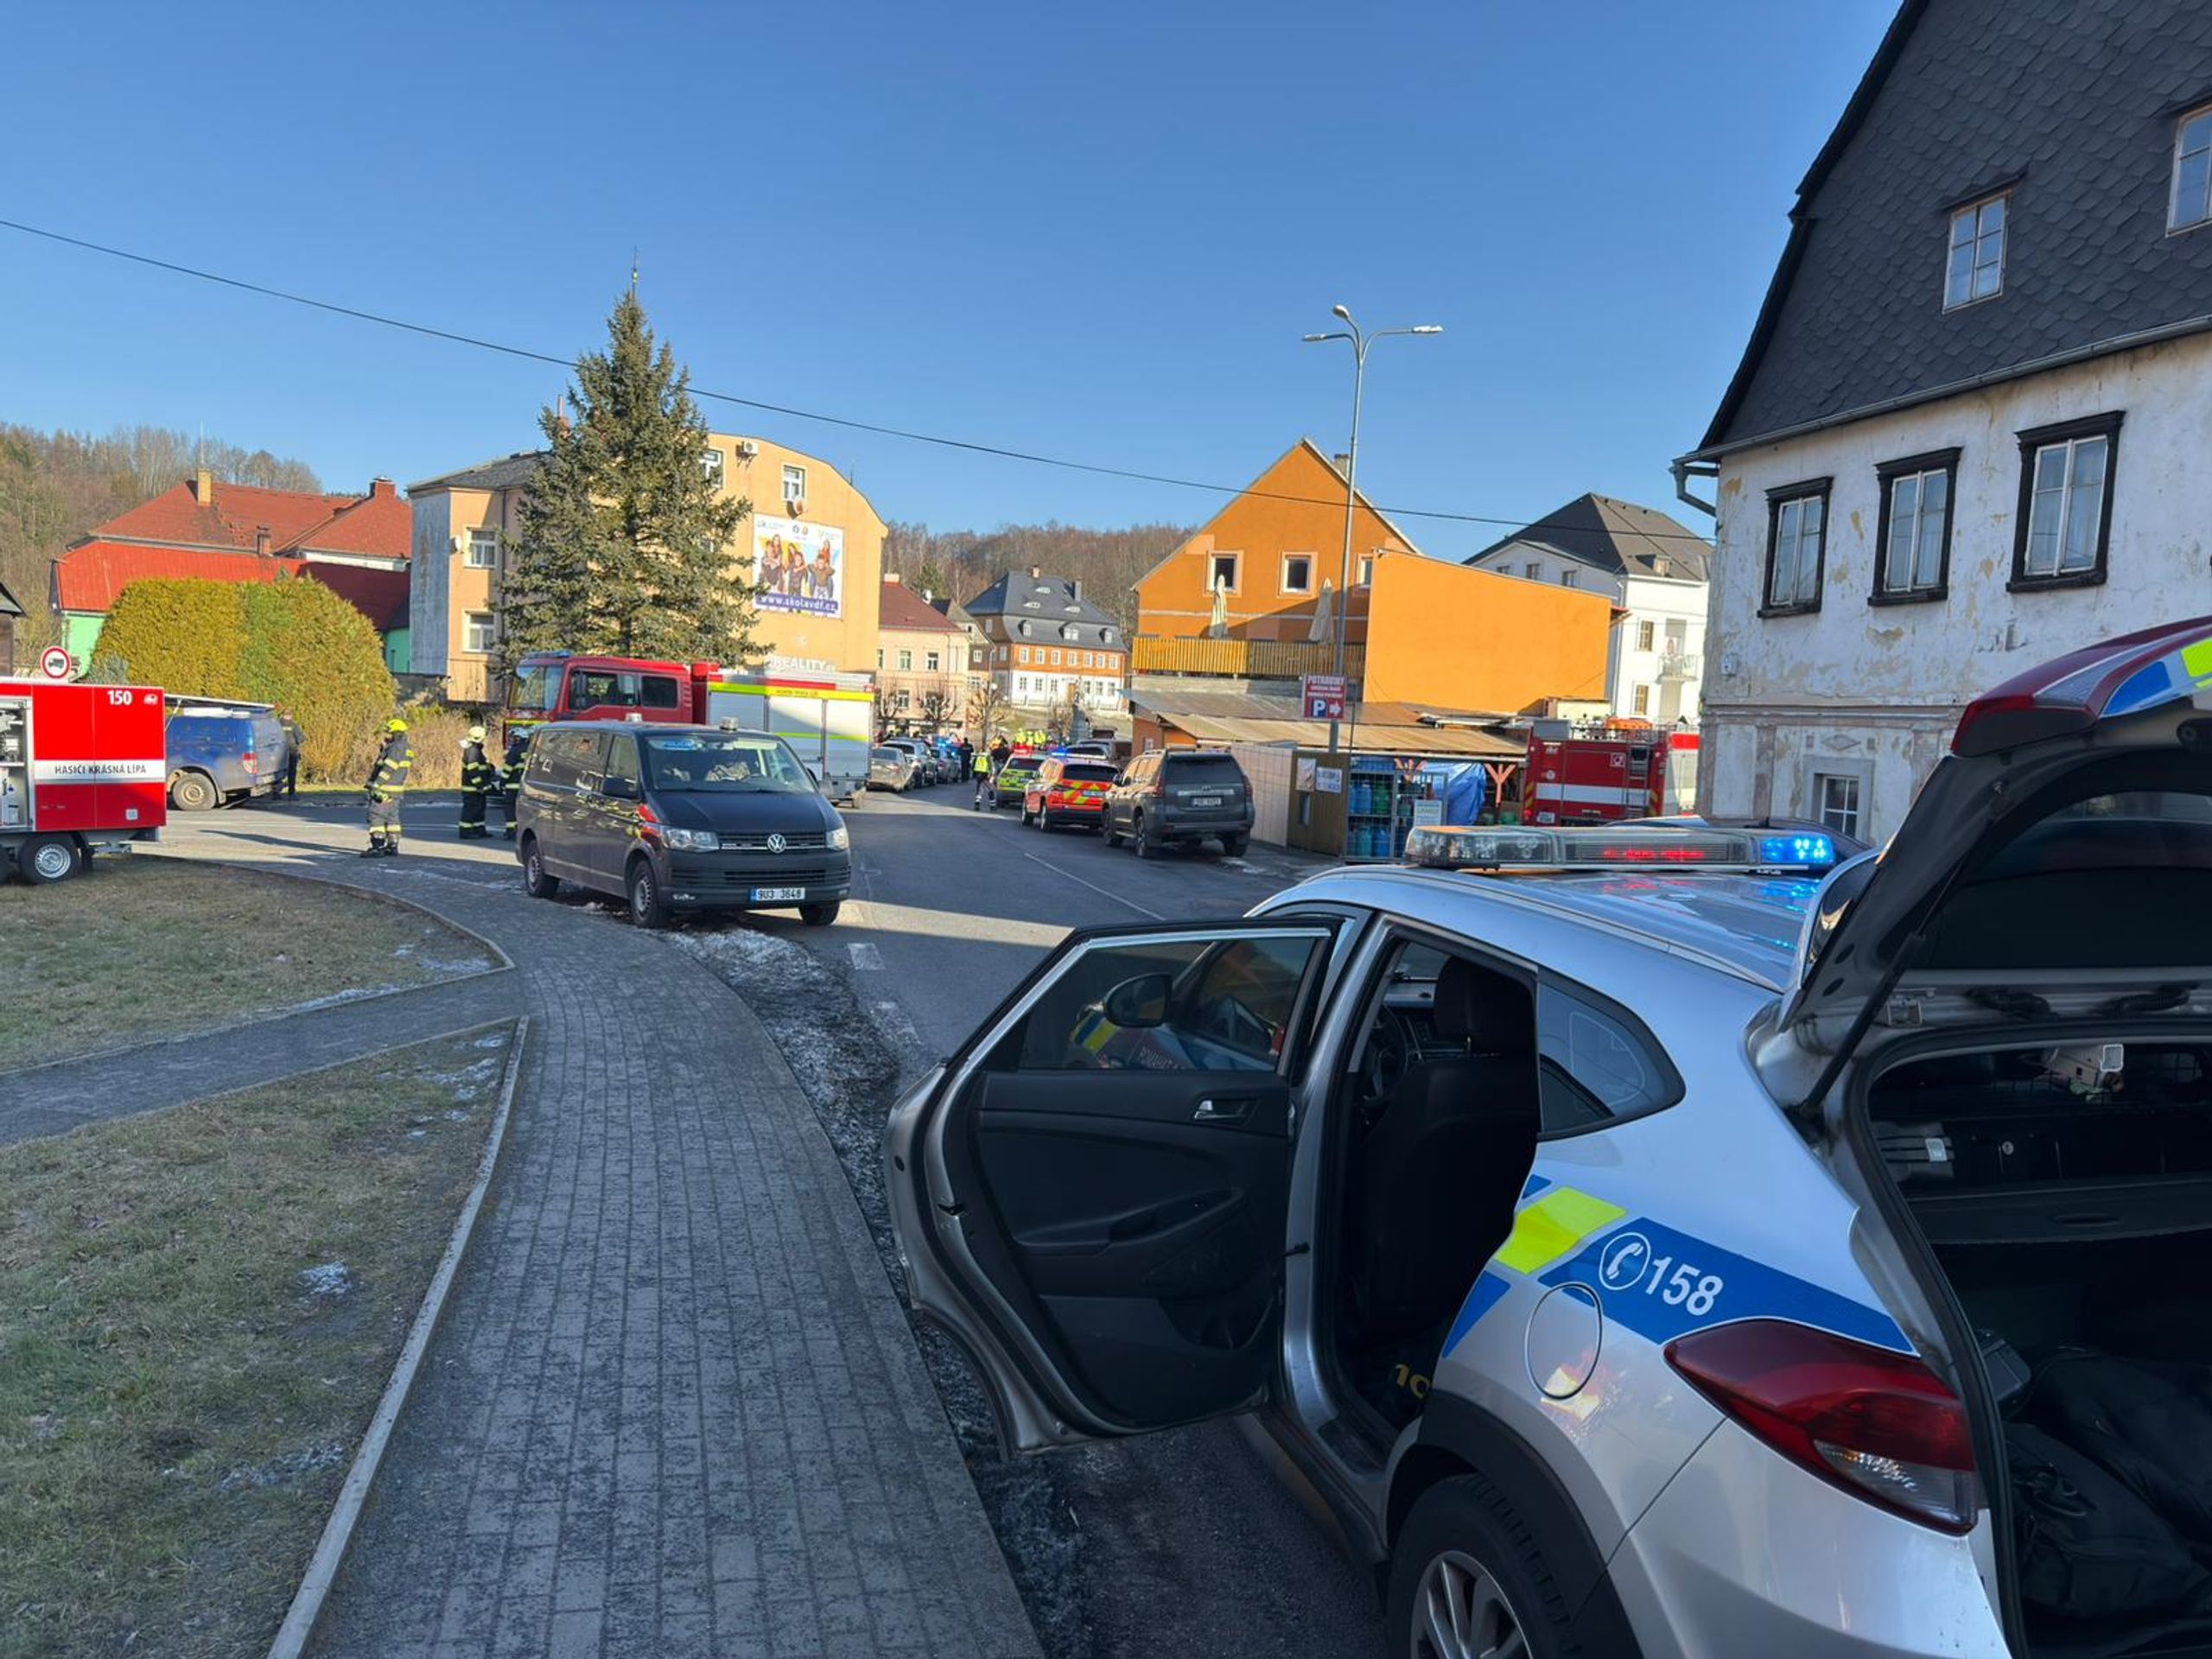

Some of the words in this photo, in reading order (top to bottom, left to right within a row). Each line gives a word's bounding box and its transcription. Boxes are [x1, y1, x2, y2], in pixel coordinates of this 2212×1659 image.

[107, 690, 132, 706] 150
[1313, 700, 1325, 716] P
[54, 765, 86, 774] HASIČI
[88, 764, 125, 774] KRÁSNÁ
[127, 764, 146, 774] LÍPA
[1644, 1255, 1723, 1316] 158
